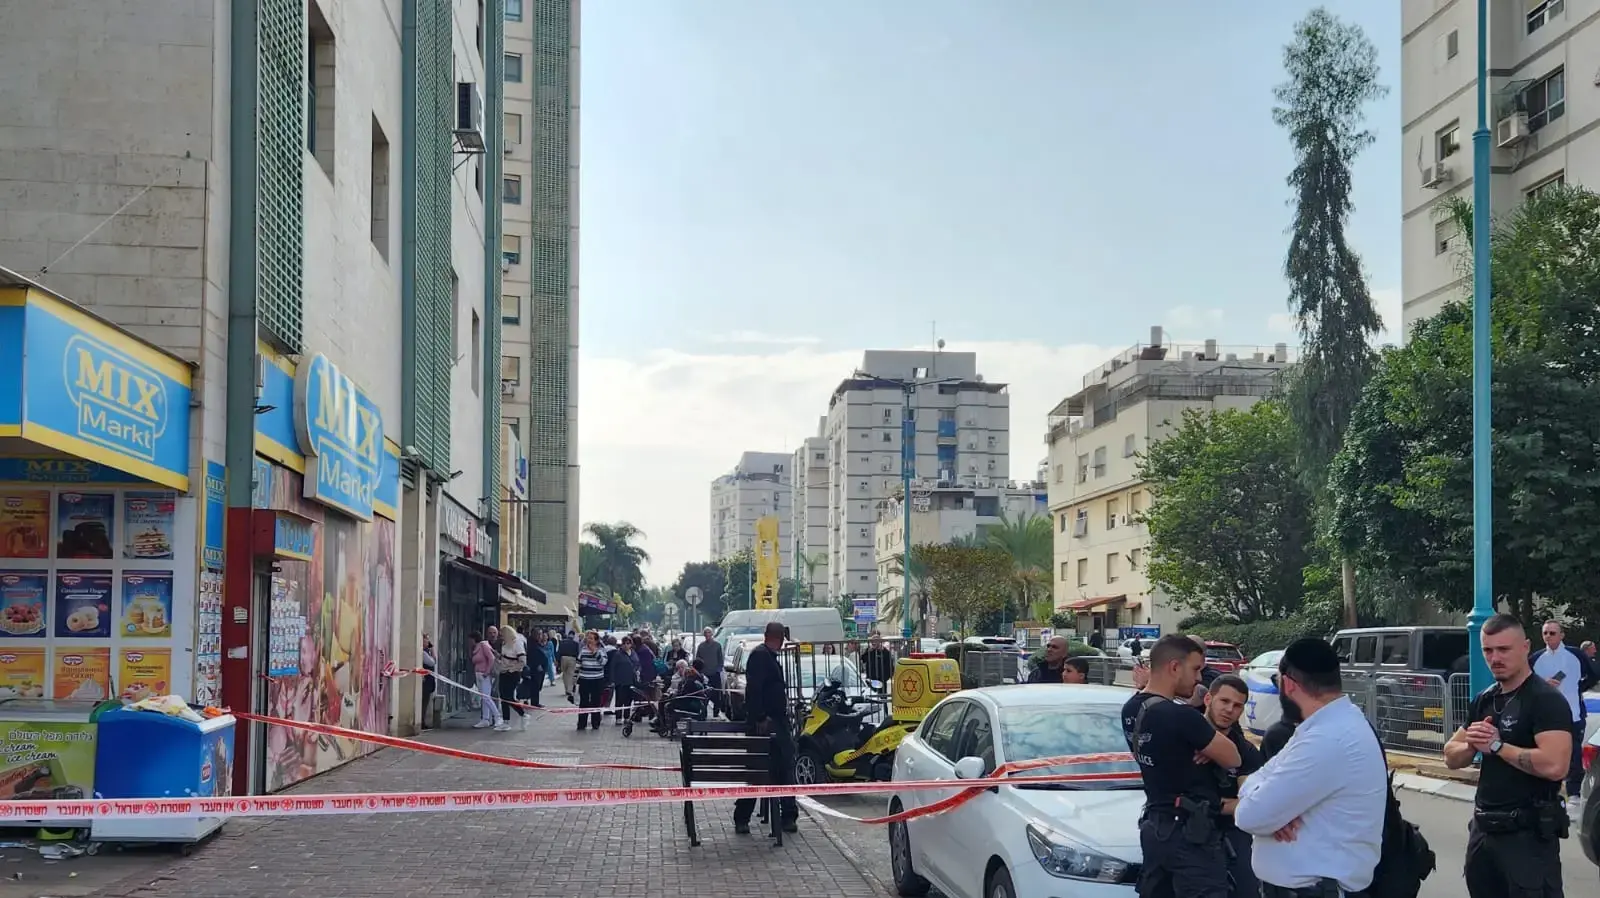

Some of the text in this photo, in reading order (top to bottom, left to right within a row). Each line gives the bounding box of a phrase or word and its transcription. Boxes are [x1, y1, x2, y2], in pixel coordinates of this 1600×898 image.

[76, 347, 160, 421] MIX
[316, 363, 381, 464] MIX
[82, 405, 153, 450] Markt
[207, 477, 225, 493] MIX
[205, 548, 223, 561] MIX
[4, 742, 37, 752] cream
[7, 752, 57, 763] ice cream
[15, 804, 48, 816] משטרת
[56, 804, 81, 816] מעבר
[82, 804, 94, 817] אין
[115, 803, 144, 815] ישראל
[160, 802, 191, 813] משטרת
[200, 803, 222, 813] מעבר
[222, 801, 234, 814] אין
[254, 800, 279, 811] ישראל
